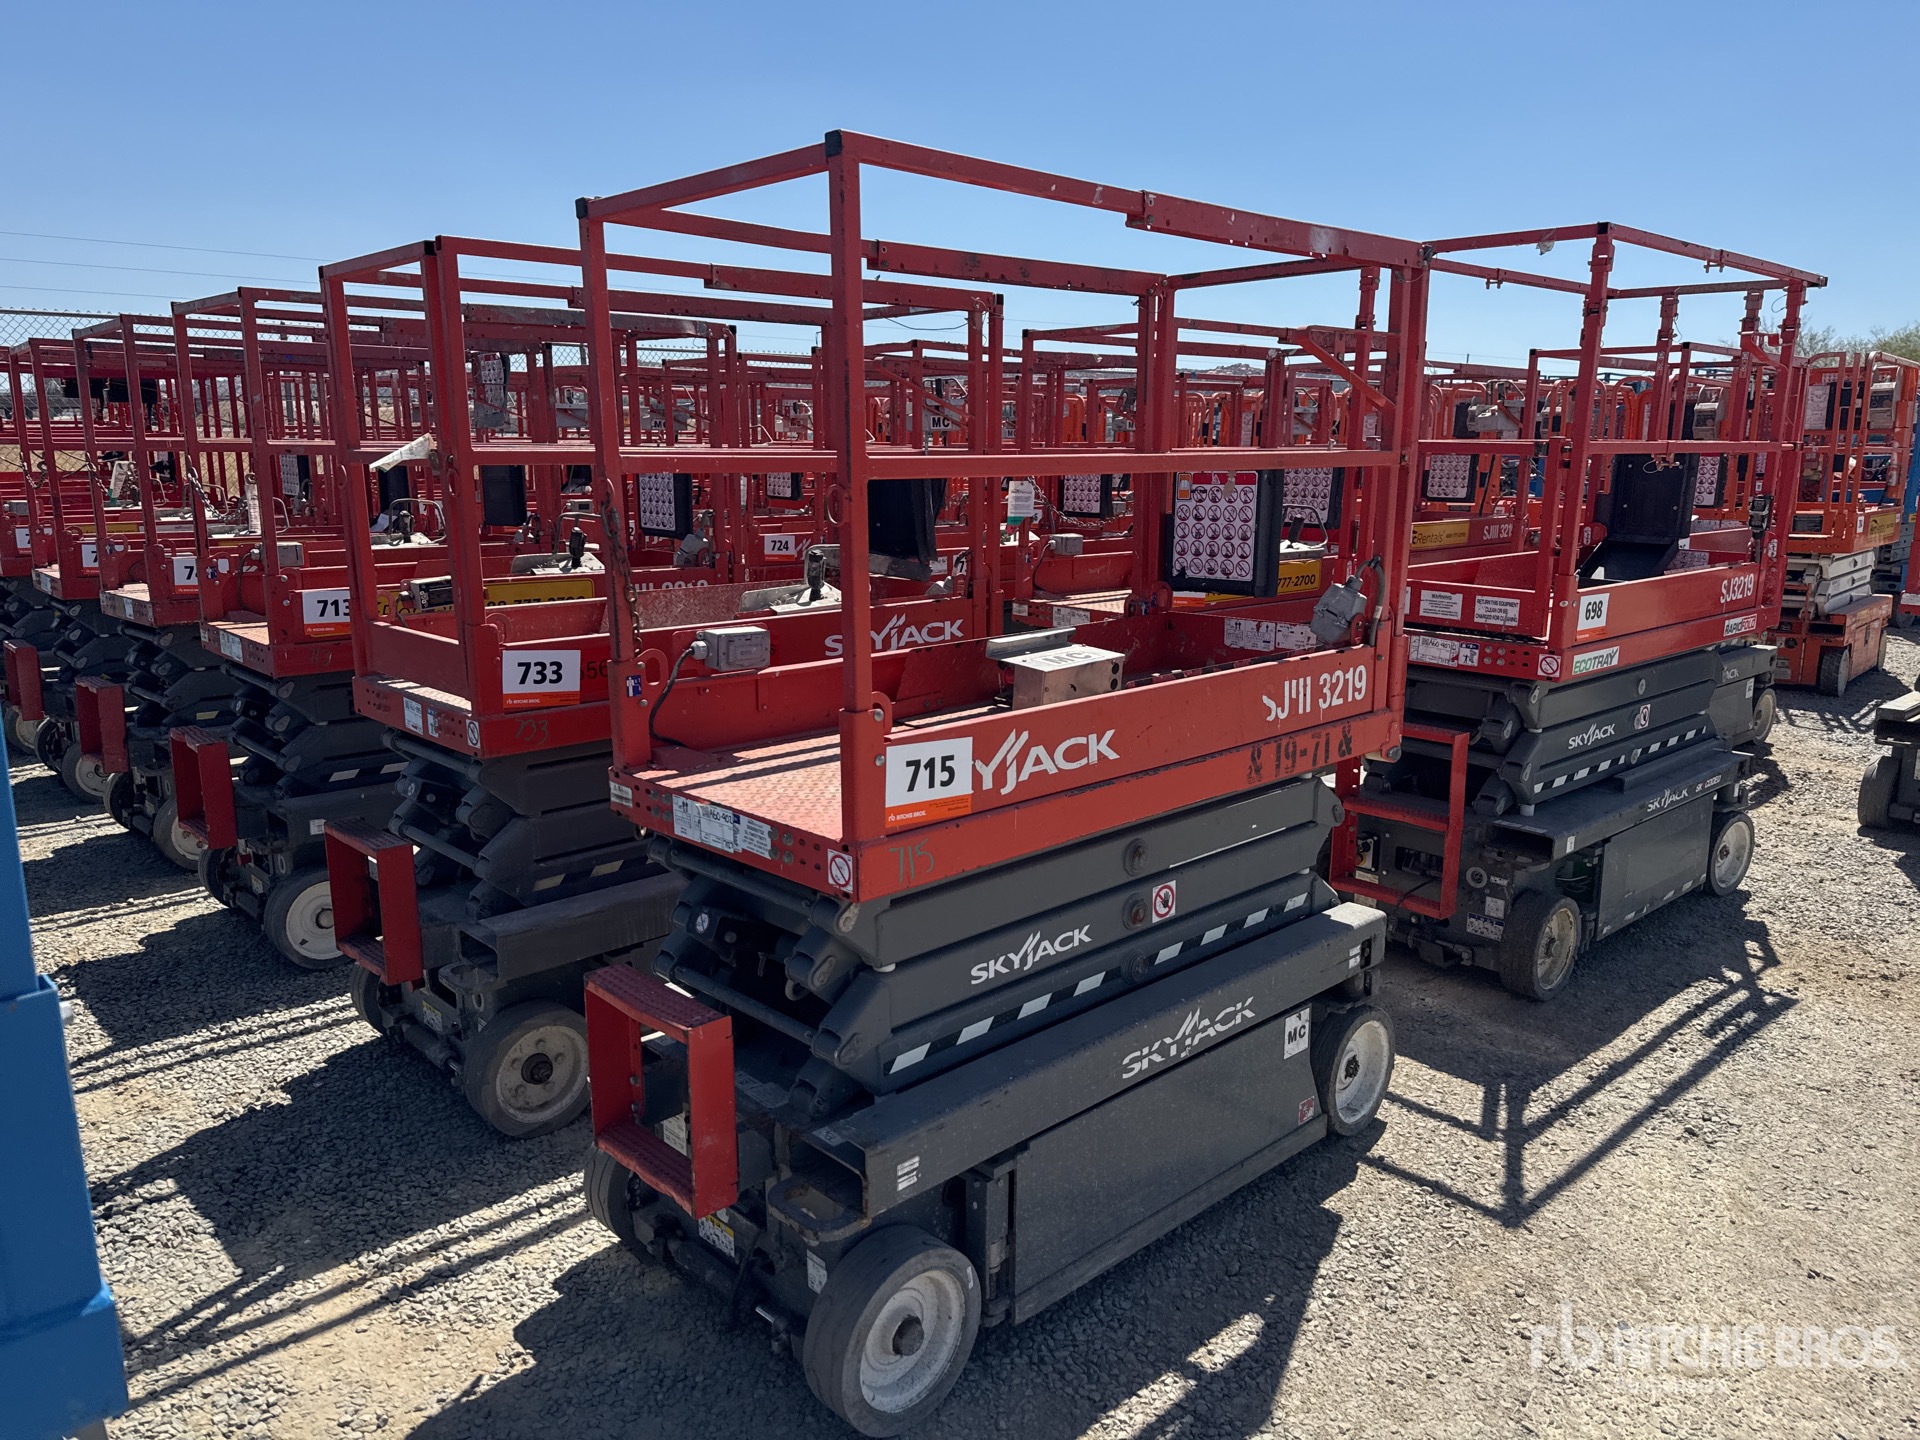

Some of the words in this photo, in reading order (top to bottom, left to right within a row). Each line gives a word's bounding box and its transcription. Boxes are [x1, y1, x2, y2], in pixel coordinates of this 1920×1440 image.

[932, 417, 950, 428] MC
[771, 540, 789, 551] 724
[1719, 573, 1754, 604] SJ3219
[1585, 600, 1603, 621] 698
[824, 613, 964, 656] SYJACK
[517, 661, 563, 685] 733
[1574, 649, 1619, 673] ECOTRAY
[1319, 665, 1367, 709] 3219
[1568, 723, 1615, 750] SKYJACK
[905, 754, 956, 792] 715
[974, 728, 1120, 795] YJACK
[1647, 788, 1688, 812] SKYJACK
[889, 838, 934, 883] 715
[970, 924, 1093, 984] SKYJACK
[1122, 996, 1256, 1080] SKYJACK
[1287, 1024, 1307, 1045] MC
